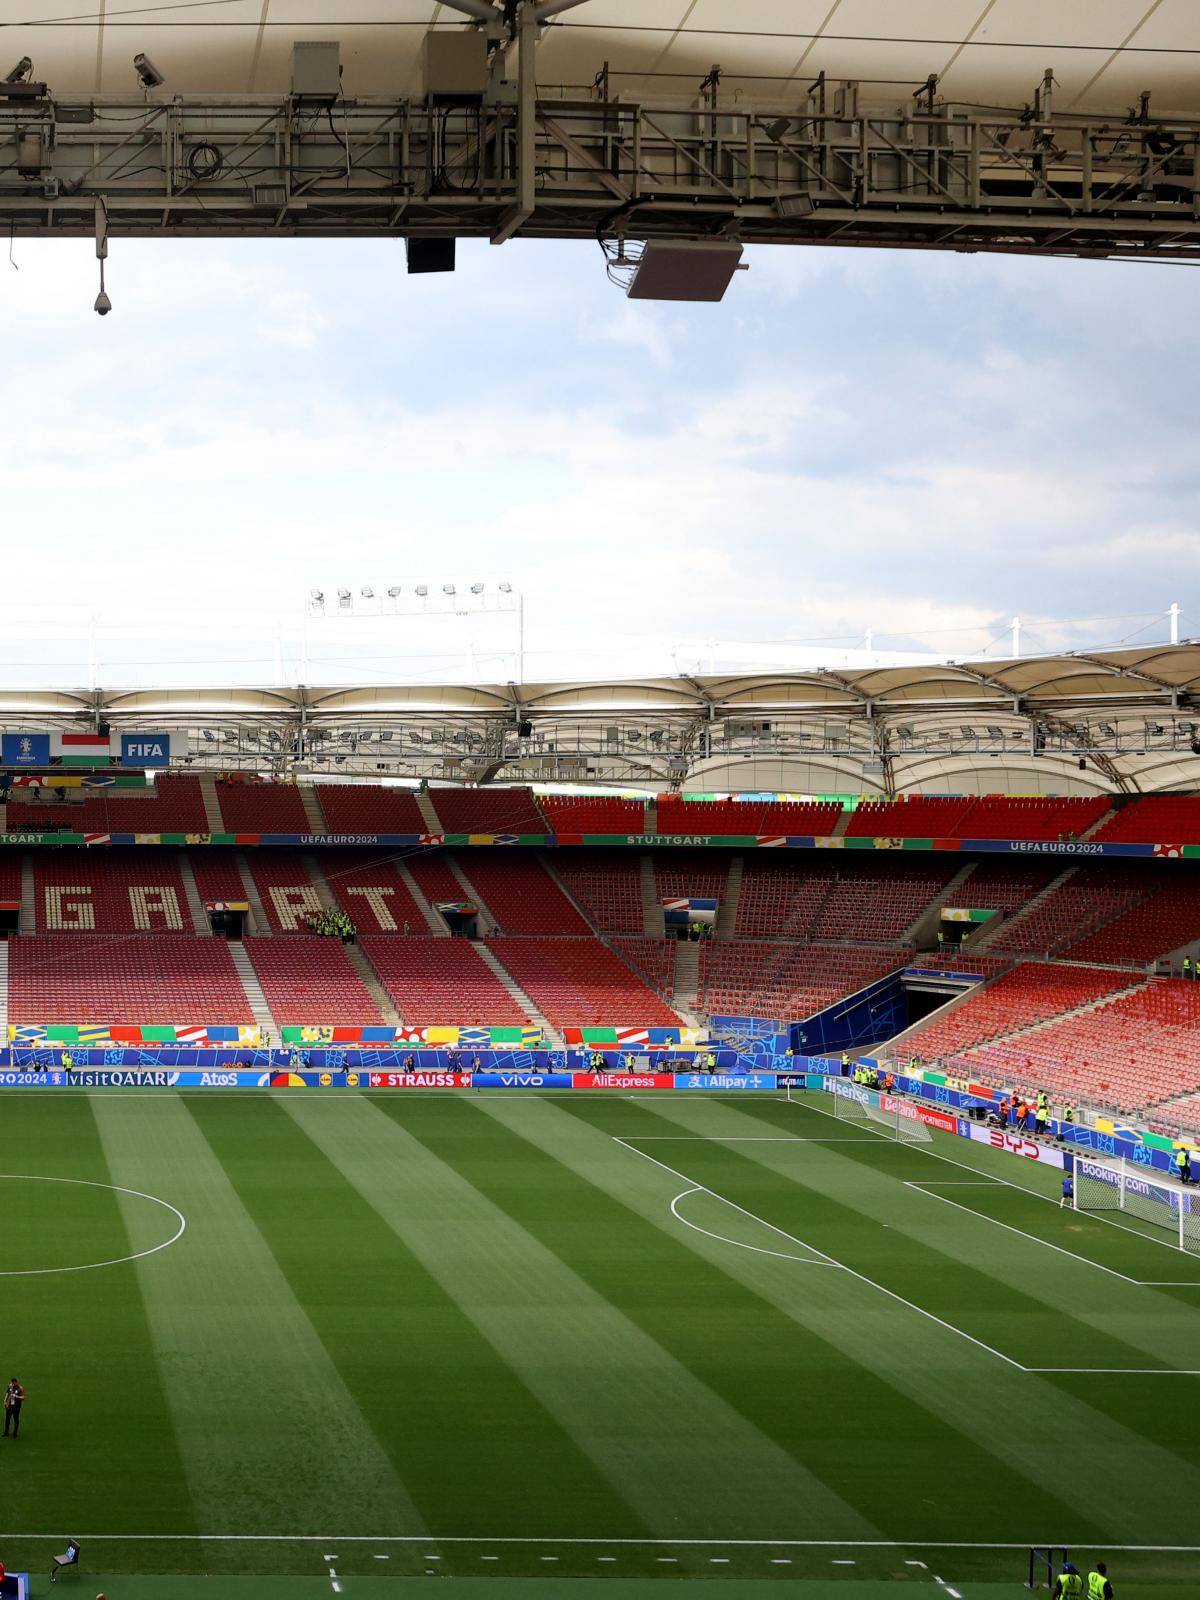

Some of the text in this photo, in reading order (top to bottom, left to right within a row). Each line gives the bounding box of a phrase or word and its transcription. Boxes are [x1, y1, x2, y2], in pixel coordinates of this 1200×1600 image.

[127, 744, 163, 757] FIFA
[626, 835, 711, 845] STUTTGART
[388, 1074, 455, 1087] STRAUSS
[500, 1074, 544, 1086] vivo
[591, 1074, 655, 1088] AliExpress
[990, 1130, 1040, 1160] BYD
